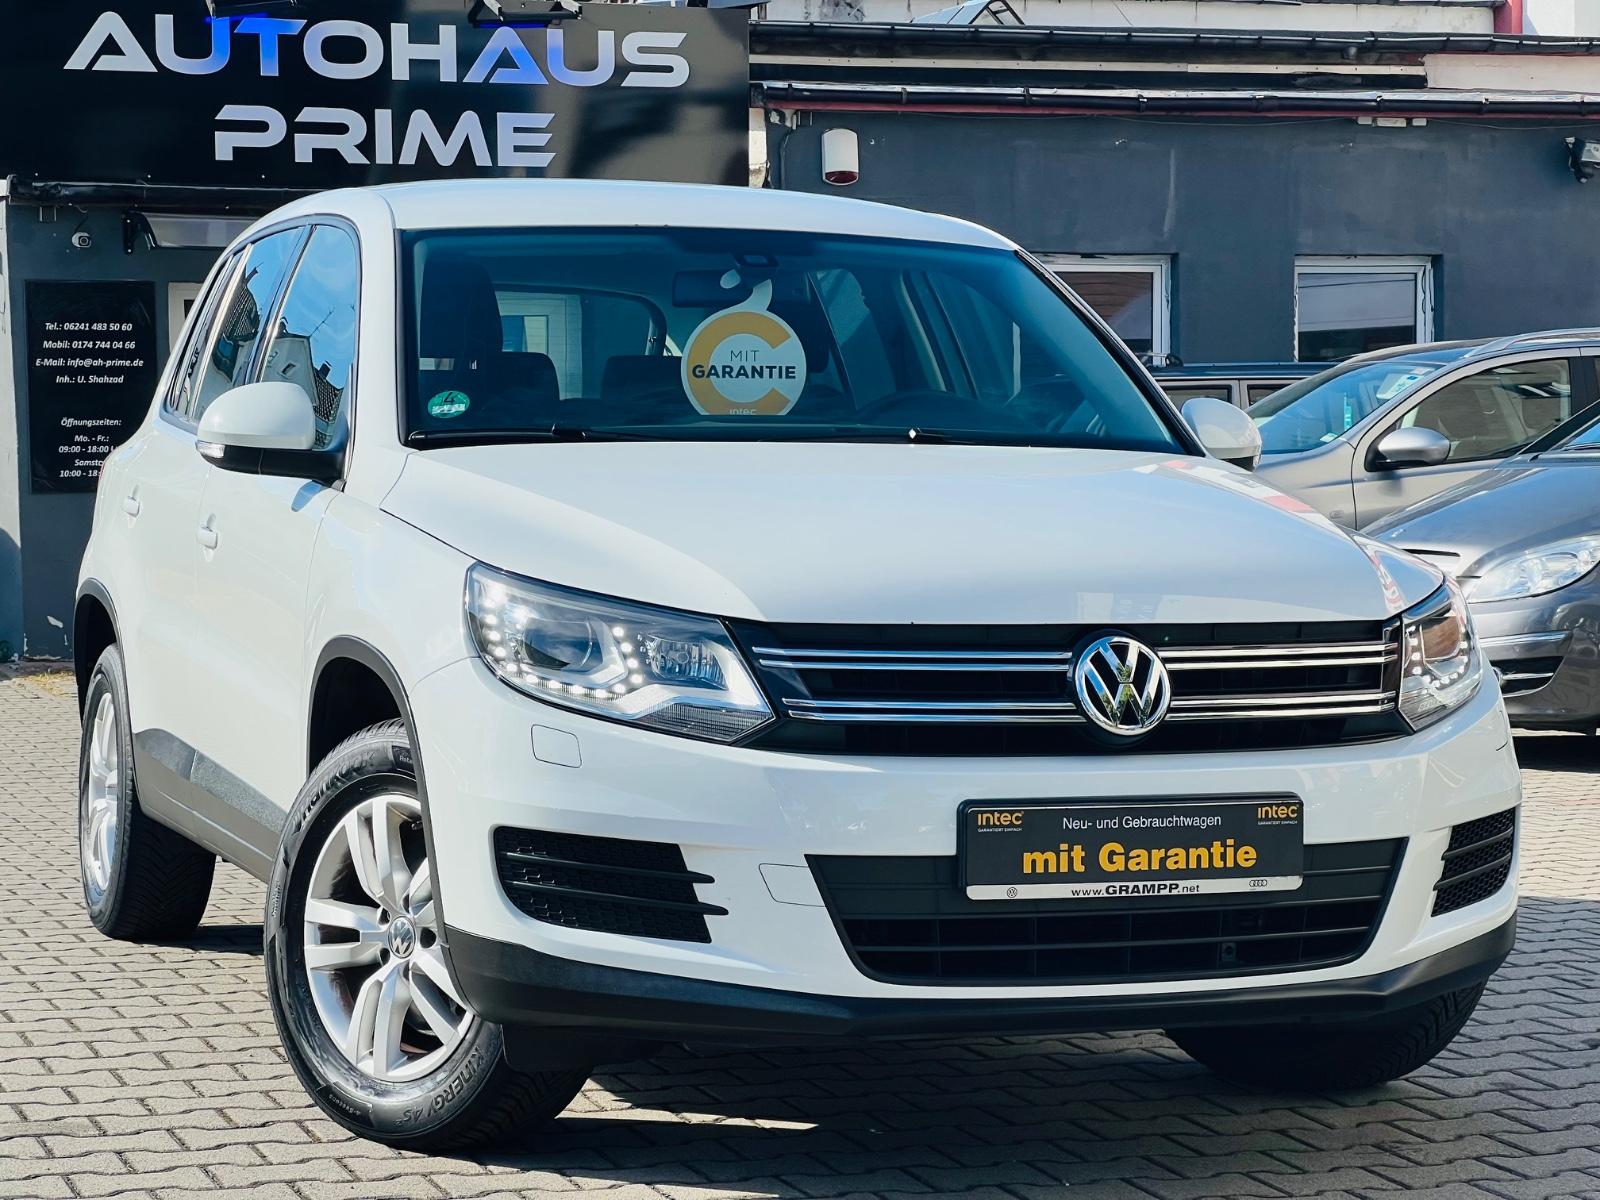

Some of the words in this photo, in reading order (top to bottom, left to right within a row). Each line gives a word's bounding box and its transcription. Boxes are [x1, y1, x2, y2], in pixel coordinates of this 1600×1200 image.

[63, 11, 690, 87] AUTOHAUS
[214, 105, 557, 168] PRIME
[45, 322, 62, 331] Tel.:
[63, 322, 89, 331] 06241
[91, 322, 107, 331] 483
[109, 323, 120, 331] 50
[121, 323, 133, 331] 60
[43, 340, 70, 349] Mobil:
[71, 340, 93, 349] 0174
[94, 340, 110, 349] 744
[112, 341, 123, 349] 04
[124, 341, 136, 349] 66
[730, 350, 759, 362] MIT
[35, 358, 66, 367] E-Mail:
[67, 358, 144, 368] info@ah-prime.de
[692, 365, 797, 379] GARANTIE
[55, 375, 76, 383] Inh.:
[77, 375, 87, 383] U.
[88, 375, 124, 383] Shahzad
[60, 417, 122, 427] Öffnungszeiten:
[74, 434, 90, 442] Mo.
[58, 445, 81, 453] 09:00
[87, 445, 110, 453] 18:00
[59, 469, 82, 478] 10:00
[1257, 805, 1298, 819] intec
[977, 811, 1023, 826] intec
[1062, 817, 1092, 829] Neu-
[1096, 816, 1119, 829] und
[1121, 815, 1222, 830] Gebrauchtwagen
[1022, 843, 1086, 874] mit
[1098, 838, 1257, 873] Garantie
[1070, 882, 1200, 897] www.GRAMPP.net
